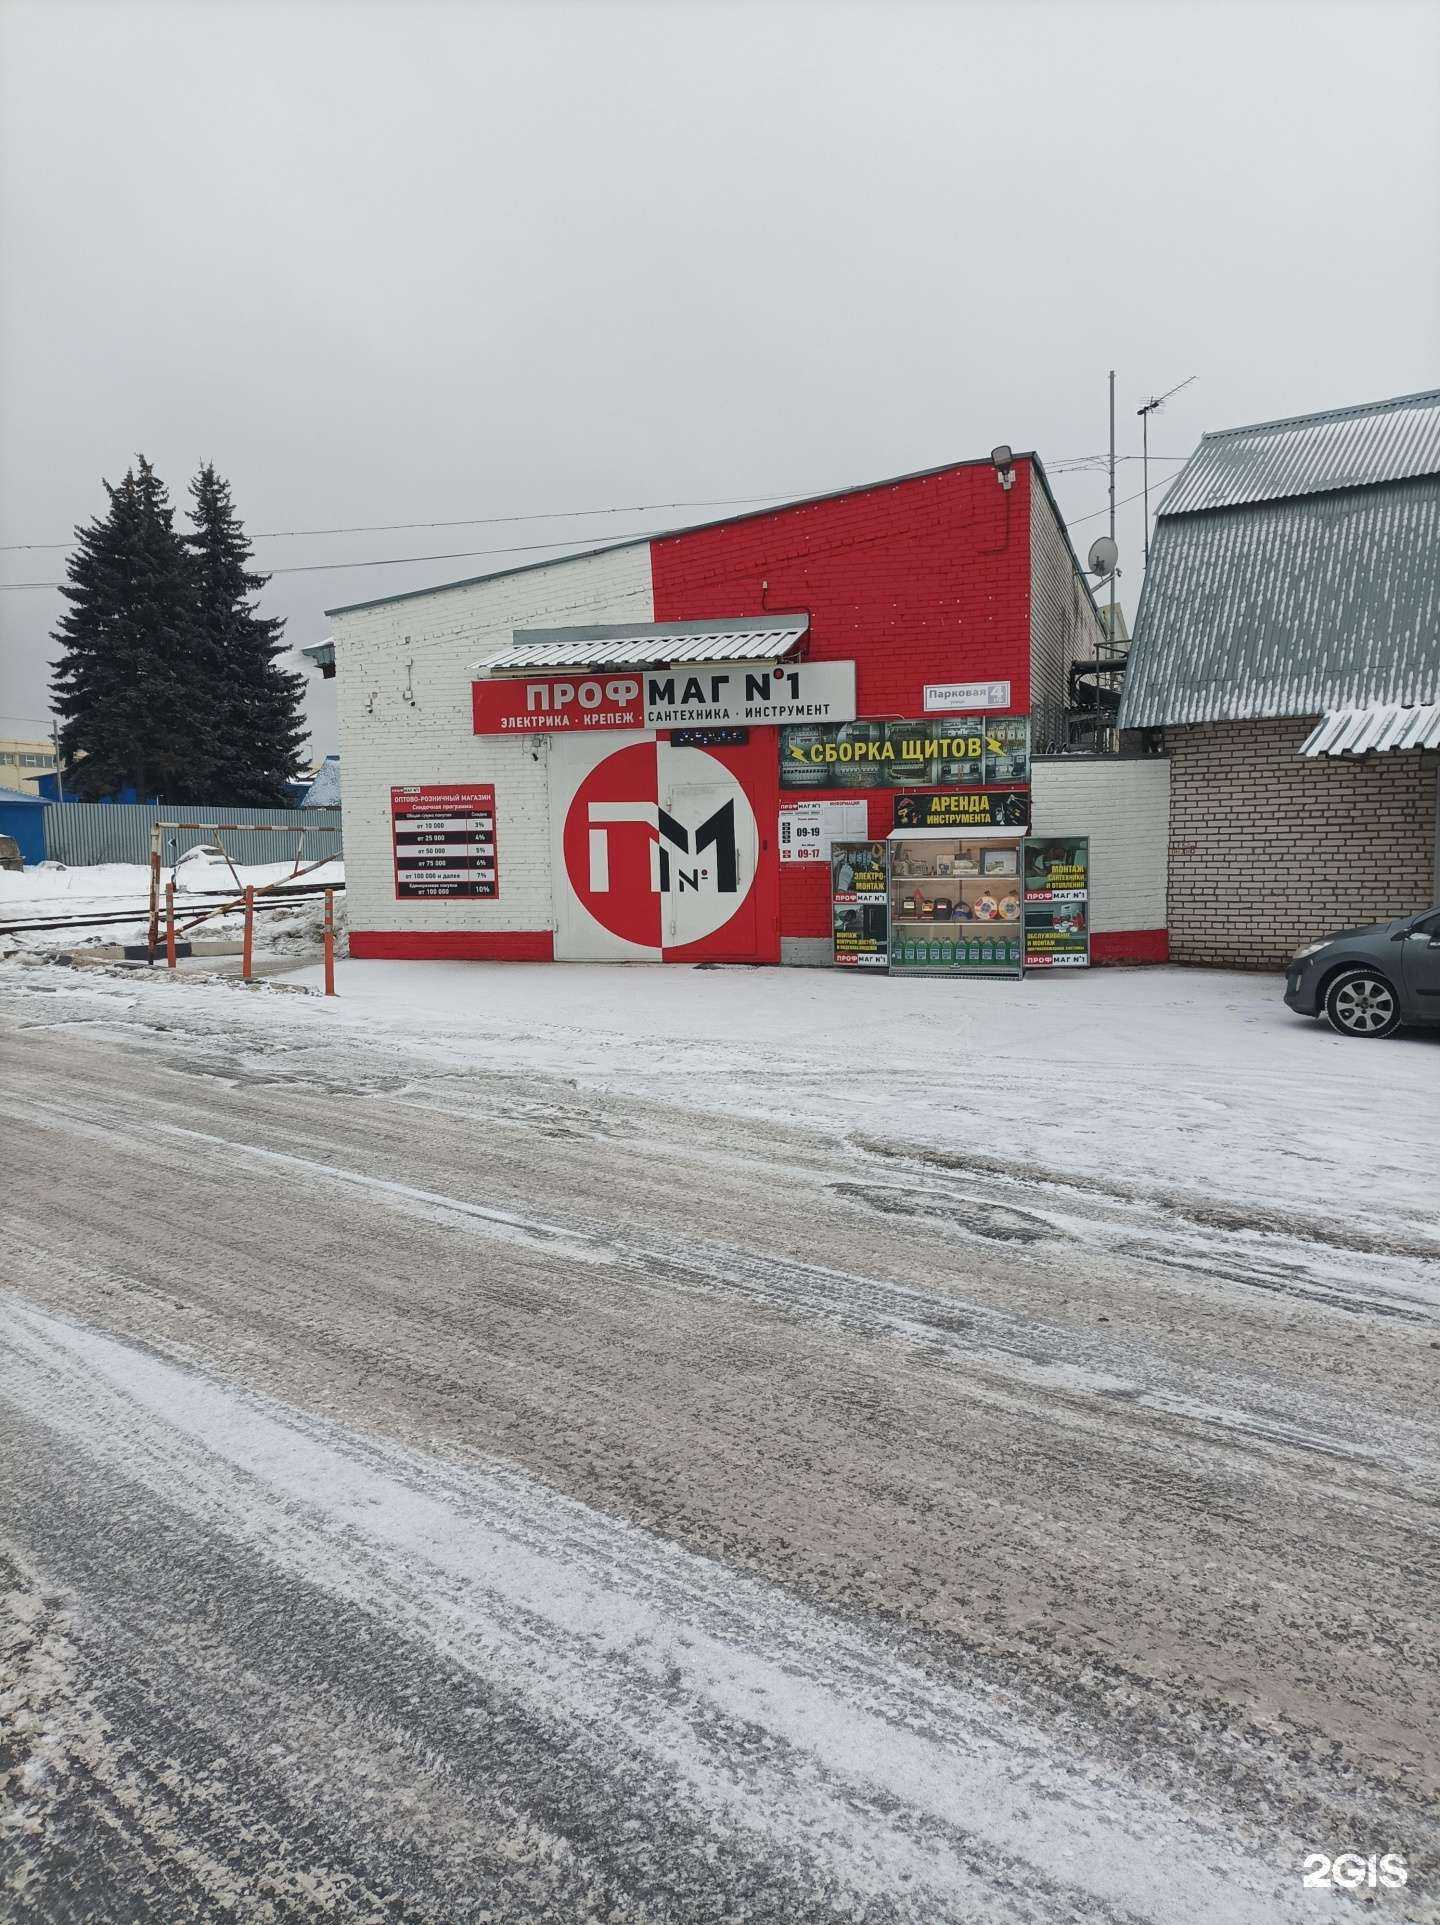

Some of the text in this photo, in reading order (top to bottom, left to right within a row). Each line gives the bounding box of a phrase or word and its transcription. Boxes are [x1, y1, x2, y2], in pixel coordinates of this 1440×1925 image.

[929, 686, 1004, 700] Парковая 4
[500, 704, 830, 728] ЭЛЕКТРИКА КРЕПЕЖ САНТЕХНИКА ИНСТРУМЕНТ
[810, 738, 982, 763] СБОРКА ЩИТОВ
[394, 793, 492, 803] ОПТОВО-РОЗНИЧНЫЙ МАГАЗИН
[931, 795, 990, 812] АРЕНДА
[927, 813, 992, 824] ИНСТРУМЕНТА
[796, 827, 820, 837] 09-19
[798, 849, 820, 858] 09-17
[1052, 864, 1084, 873] МОНТАЖ
[856, 882, 884, 890] МОНТАЖ
